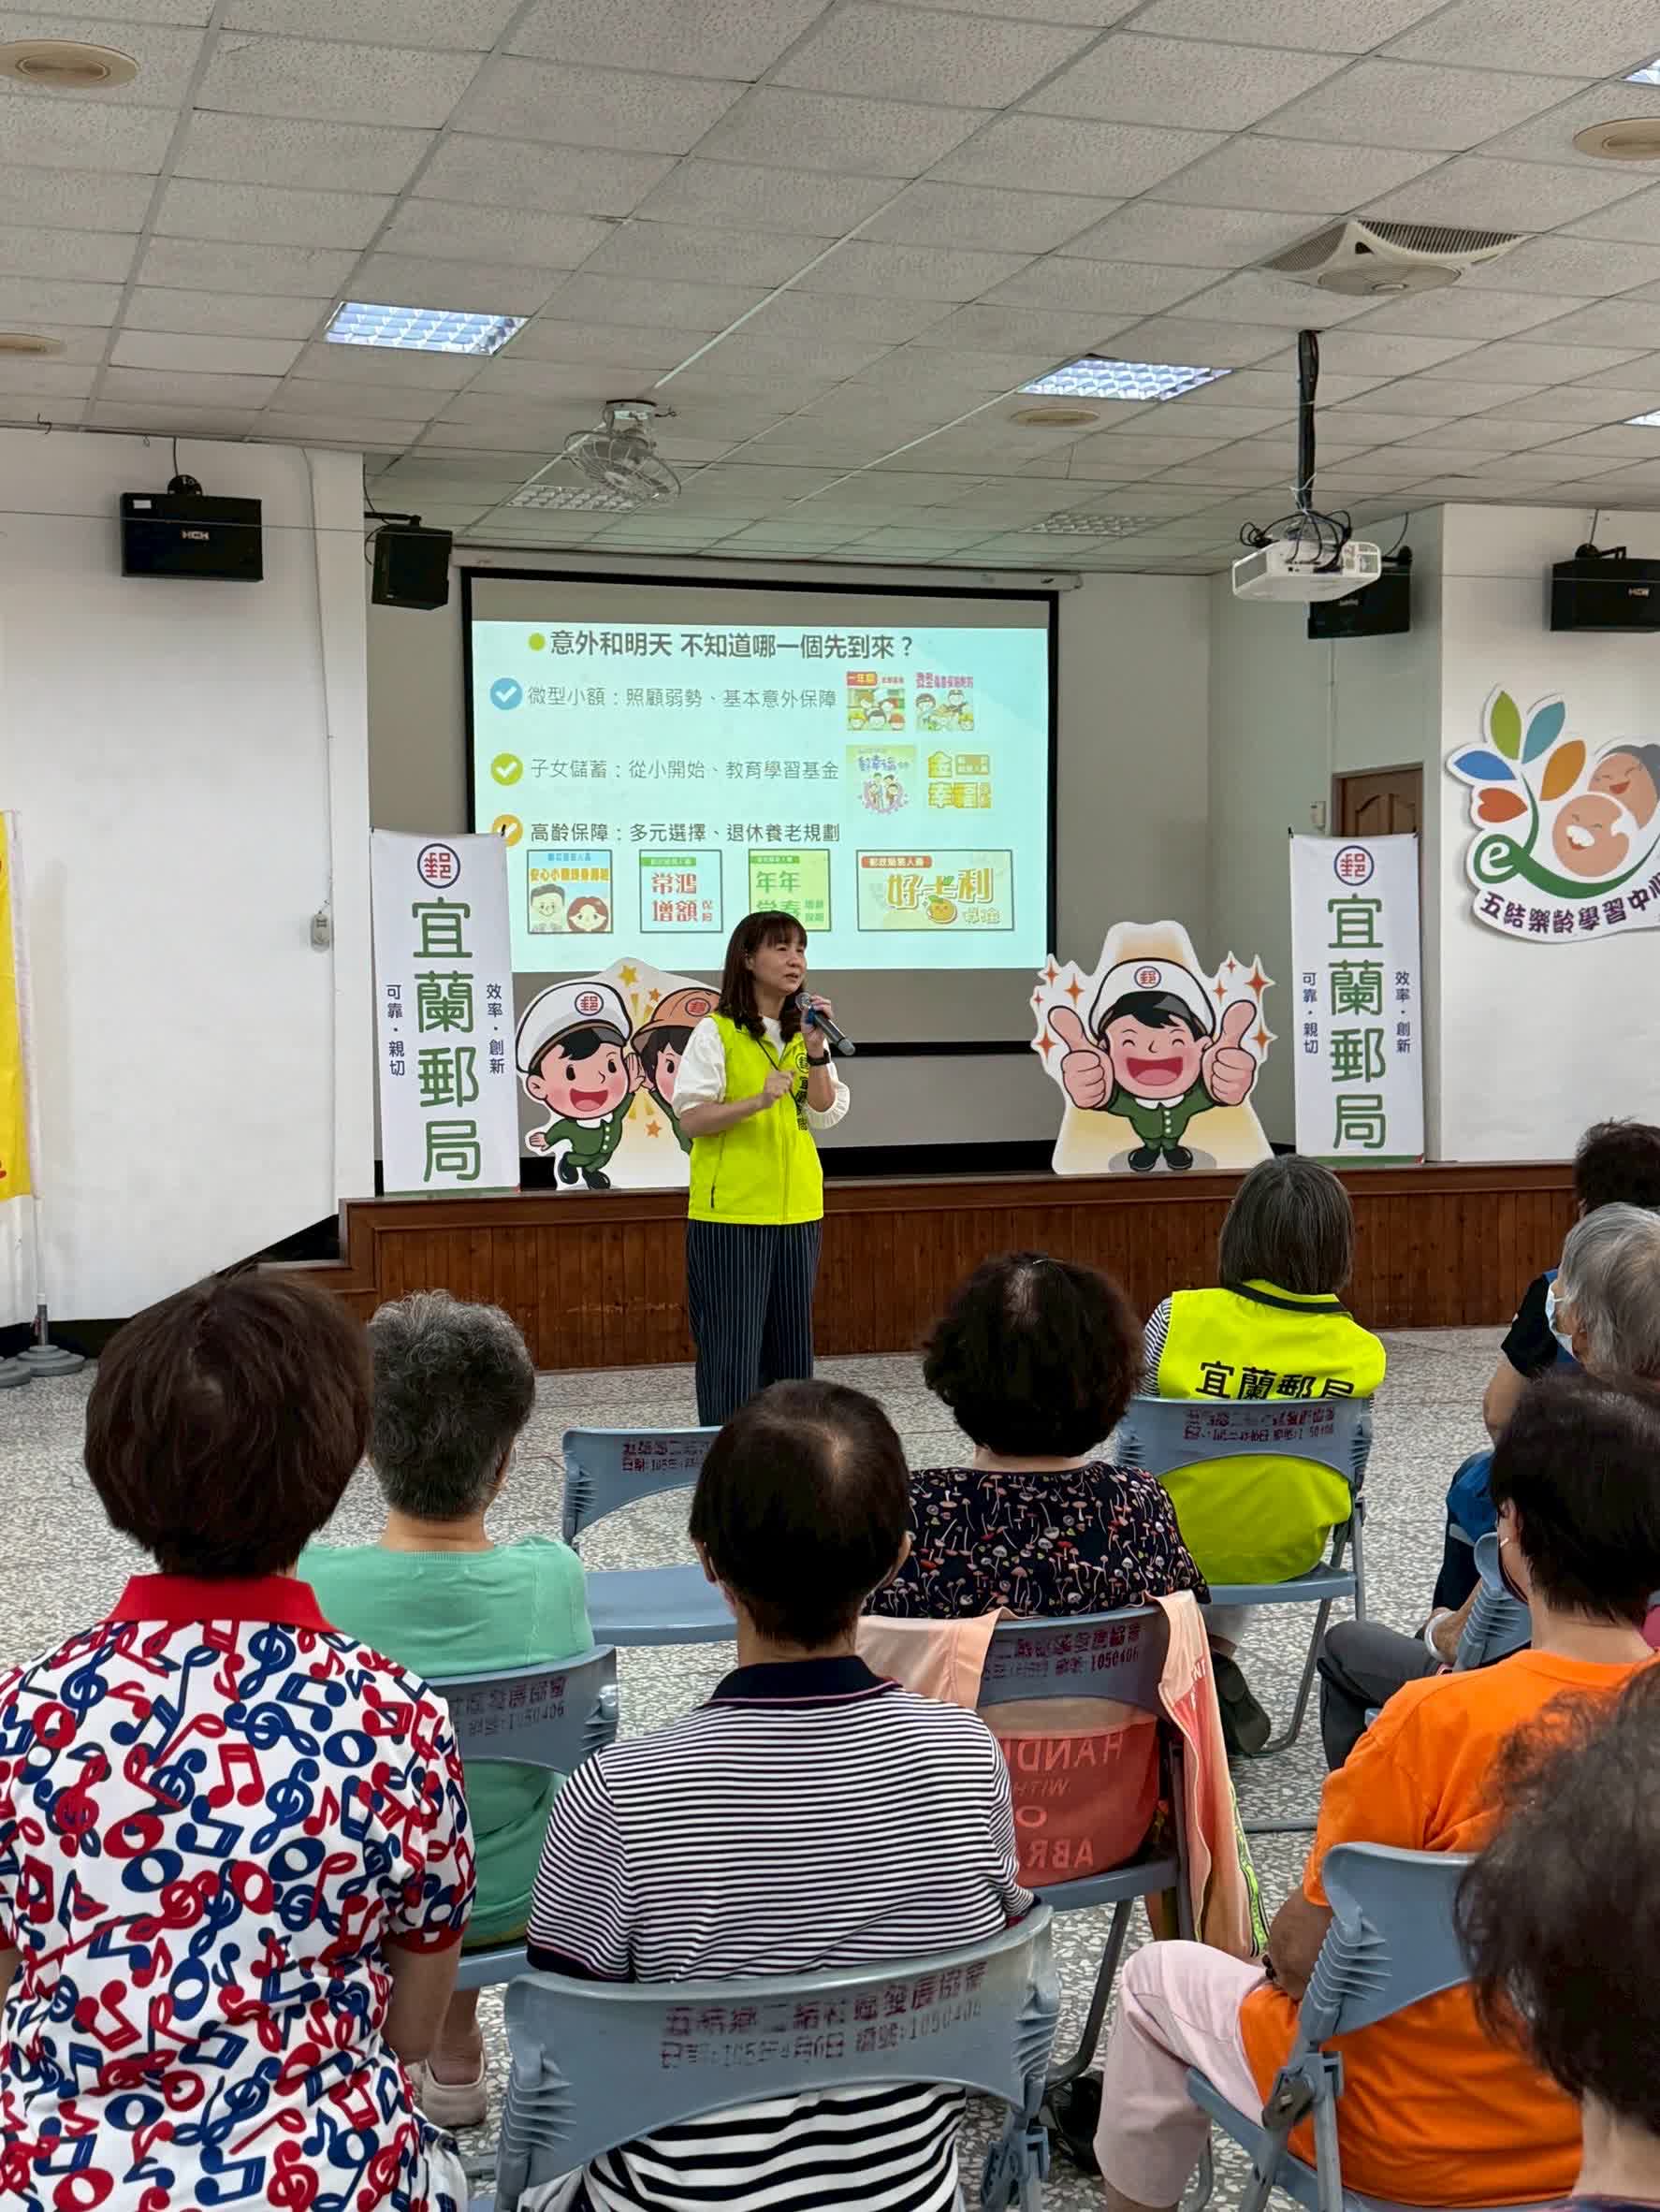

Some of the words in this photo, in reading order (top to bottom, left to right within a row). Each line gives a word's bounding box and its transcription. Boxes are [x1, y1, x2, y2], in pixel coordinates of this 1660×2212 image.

[550, 630, 673, 657] 意外和明天
[680, 633, 913, 659] 不知道哪一個先到來？
[531, 822, 840, 842] 高齡保障：多元選擇、退休養老規劃
[756, 870, 801, 894] 年年
[1327, 893, 1388, 1150] 宜蘭郵局
[412, 896, 481, 1183] 宜蘭郵局
